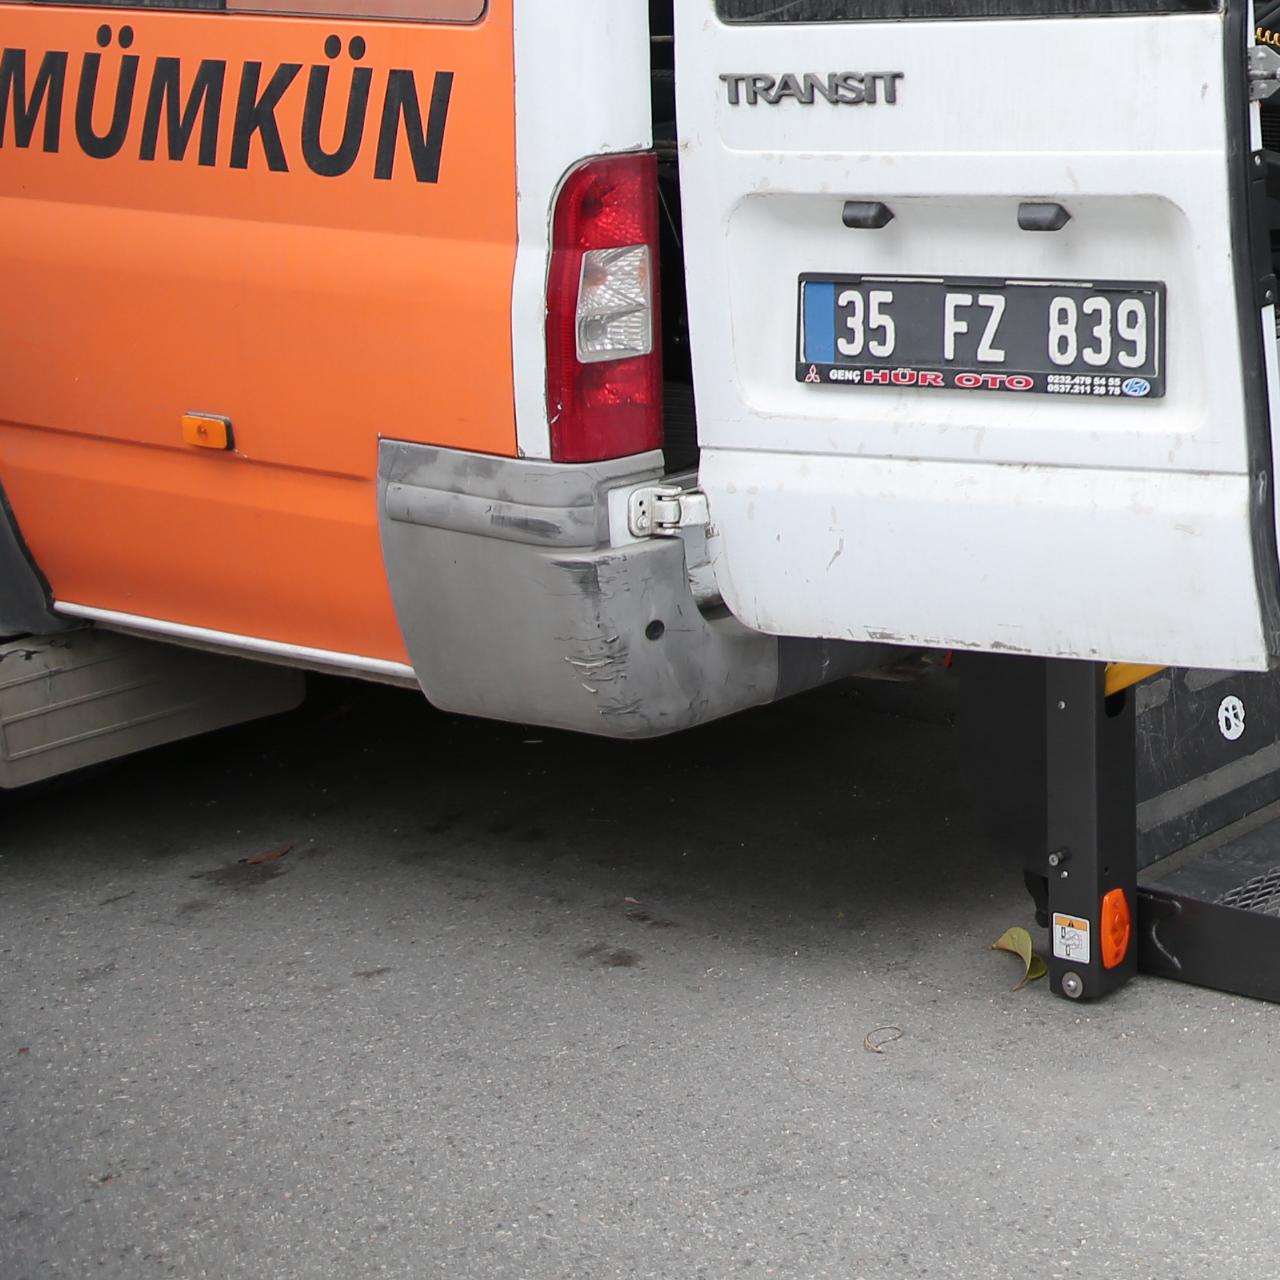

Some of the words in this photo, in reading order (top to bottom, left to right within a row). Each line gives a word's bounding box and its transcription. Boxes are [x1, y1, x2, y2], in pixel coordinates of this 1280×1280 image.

[0, 24, 454, 184] MÜMKÜN
[718, 71, 905, 105] TRANSIT
[837, 290, 895, 358] 35
[944, 293, 1005, 362] FZ
[1049, 296, 1147, 368] 839
[829, 369, 861, 383] GENÇ
[863, 368, 945, 386] HÜR
[954, 373, 1034, 391] OTO
